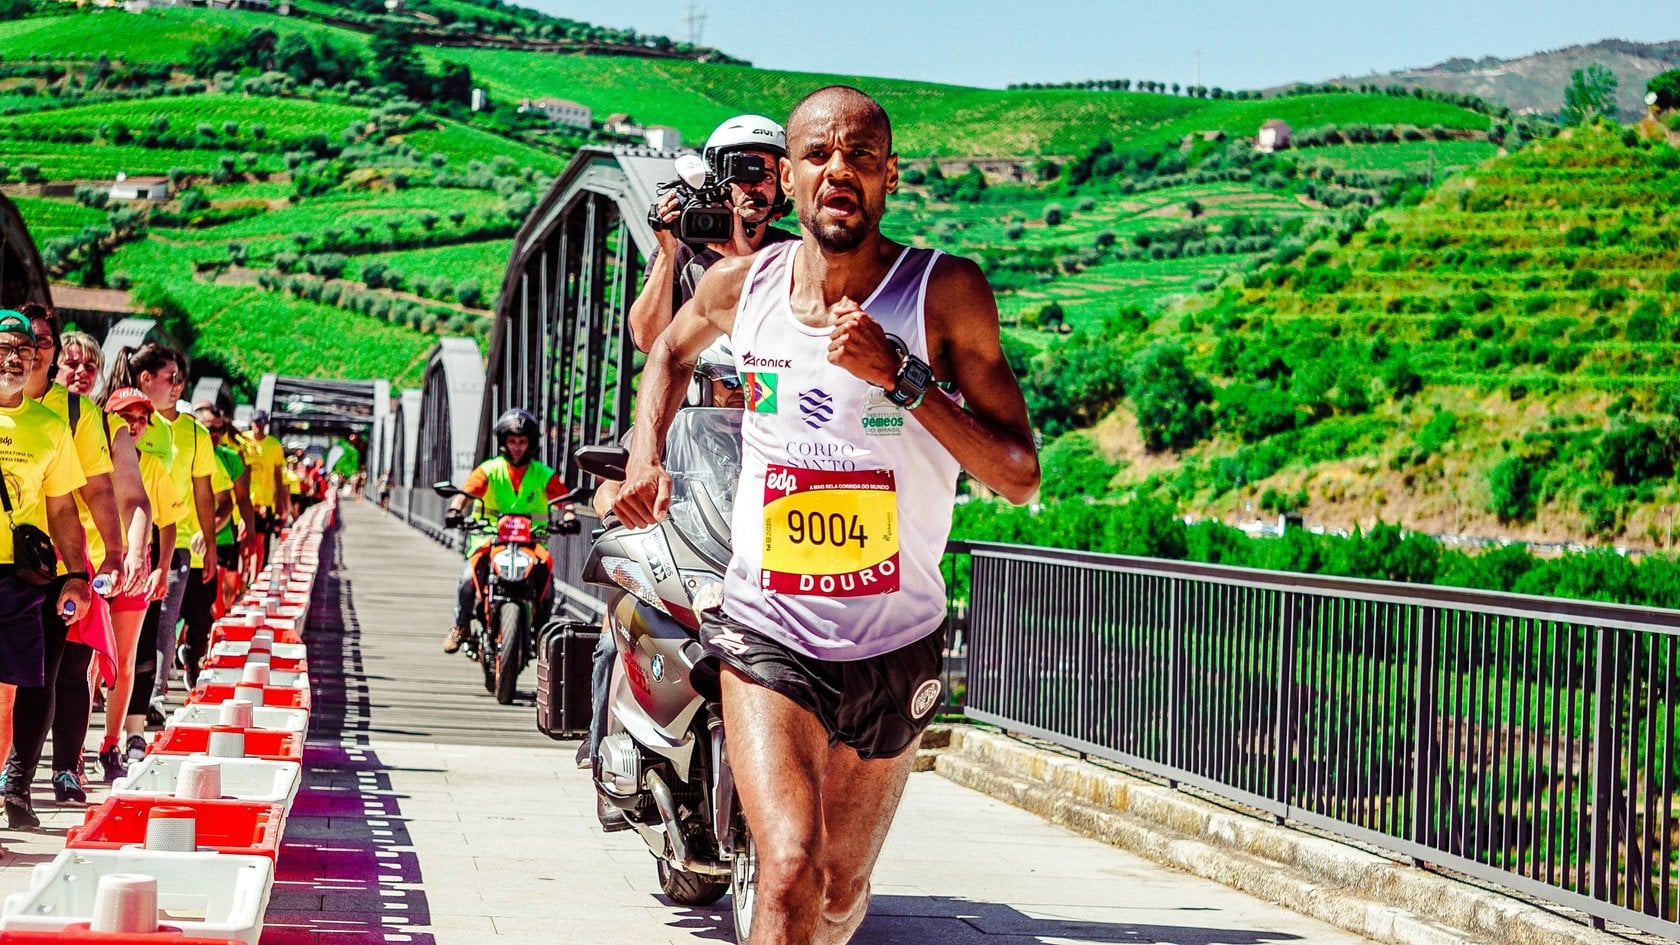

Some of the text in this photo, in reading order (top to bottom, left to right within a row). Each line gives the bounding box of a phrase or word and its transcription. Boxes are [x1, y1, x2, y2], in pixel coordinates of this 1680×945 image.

[786, 442, 854, 456] CORPO
[787, 458, 855, 471] SANTO
[767, 469, 798, 496] edp
[787, 510, 868, 548] 9004
[800, 560, 895, 593] DOURO
